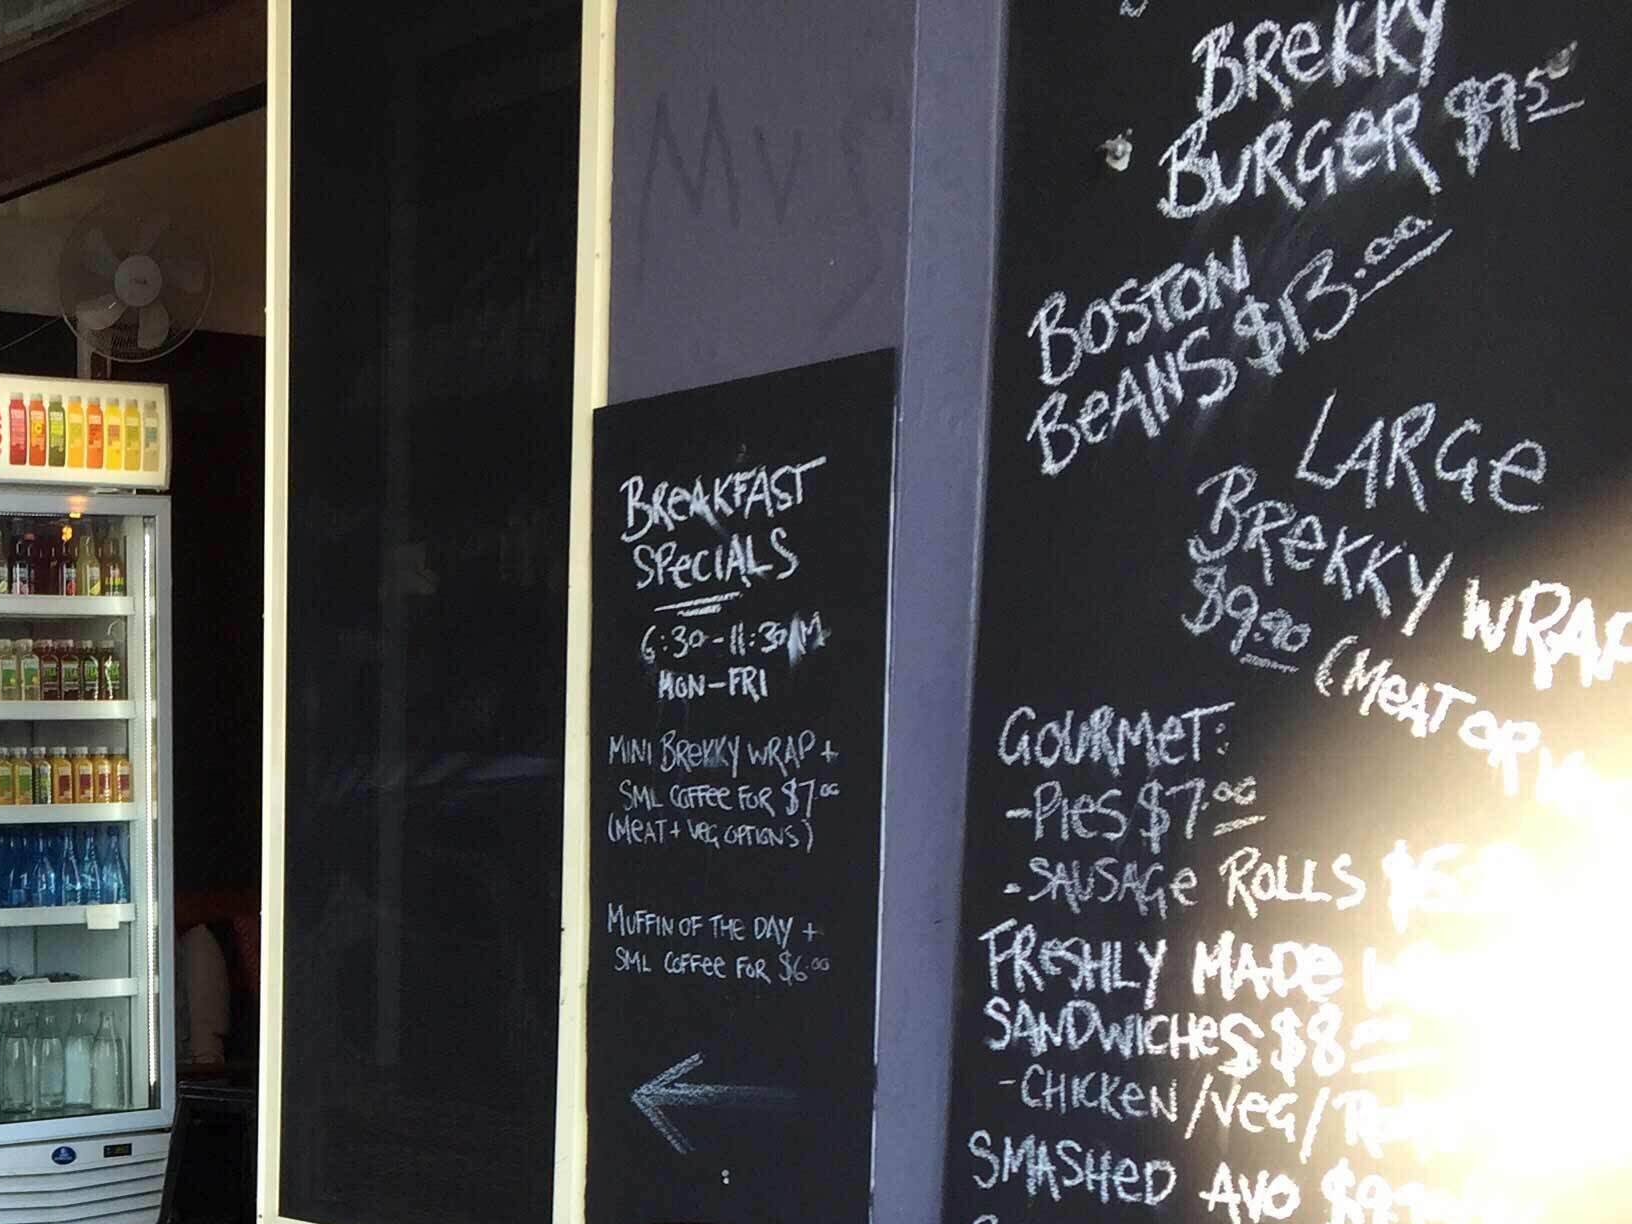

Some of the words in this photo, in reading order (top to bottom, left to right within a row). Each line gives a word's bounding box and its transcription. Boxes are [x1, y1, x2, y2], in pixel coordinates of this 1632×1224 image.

[1027, 235, 1251, 386] BOSTON
[609, 736, 652, 765] MINI
[748, 729, 816, 777] WRAP
[619, 779, 664, 811] SML
[738, 786, 776, 817] FOR
[1219, 845, 1366, 919] ROLLS
[607, 902, 673, 937] MUFFIN
[678, 915, 703, 937] OF
[754, 915, 793, 949] DAY
[615, 946, 651, 973] SML
[736, 956, 771, 984] FOR
